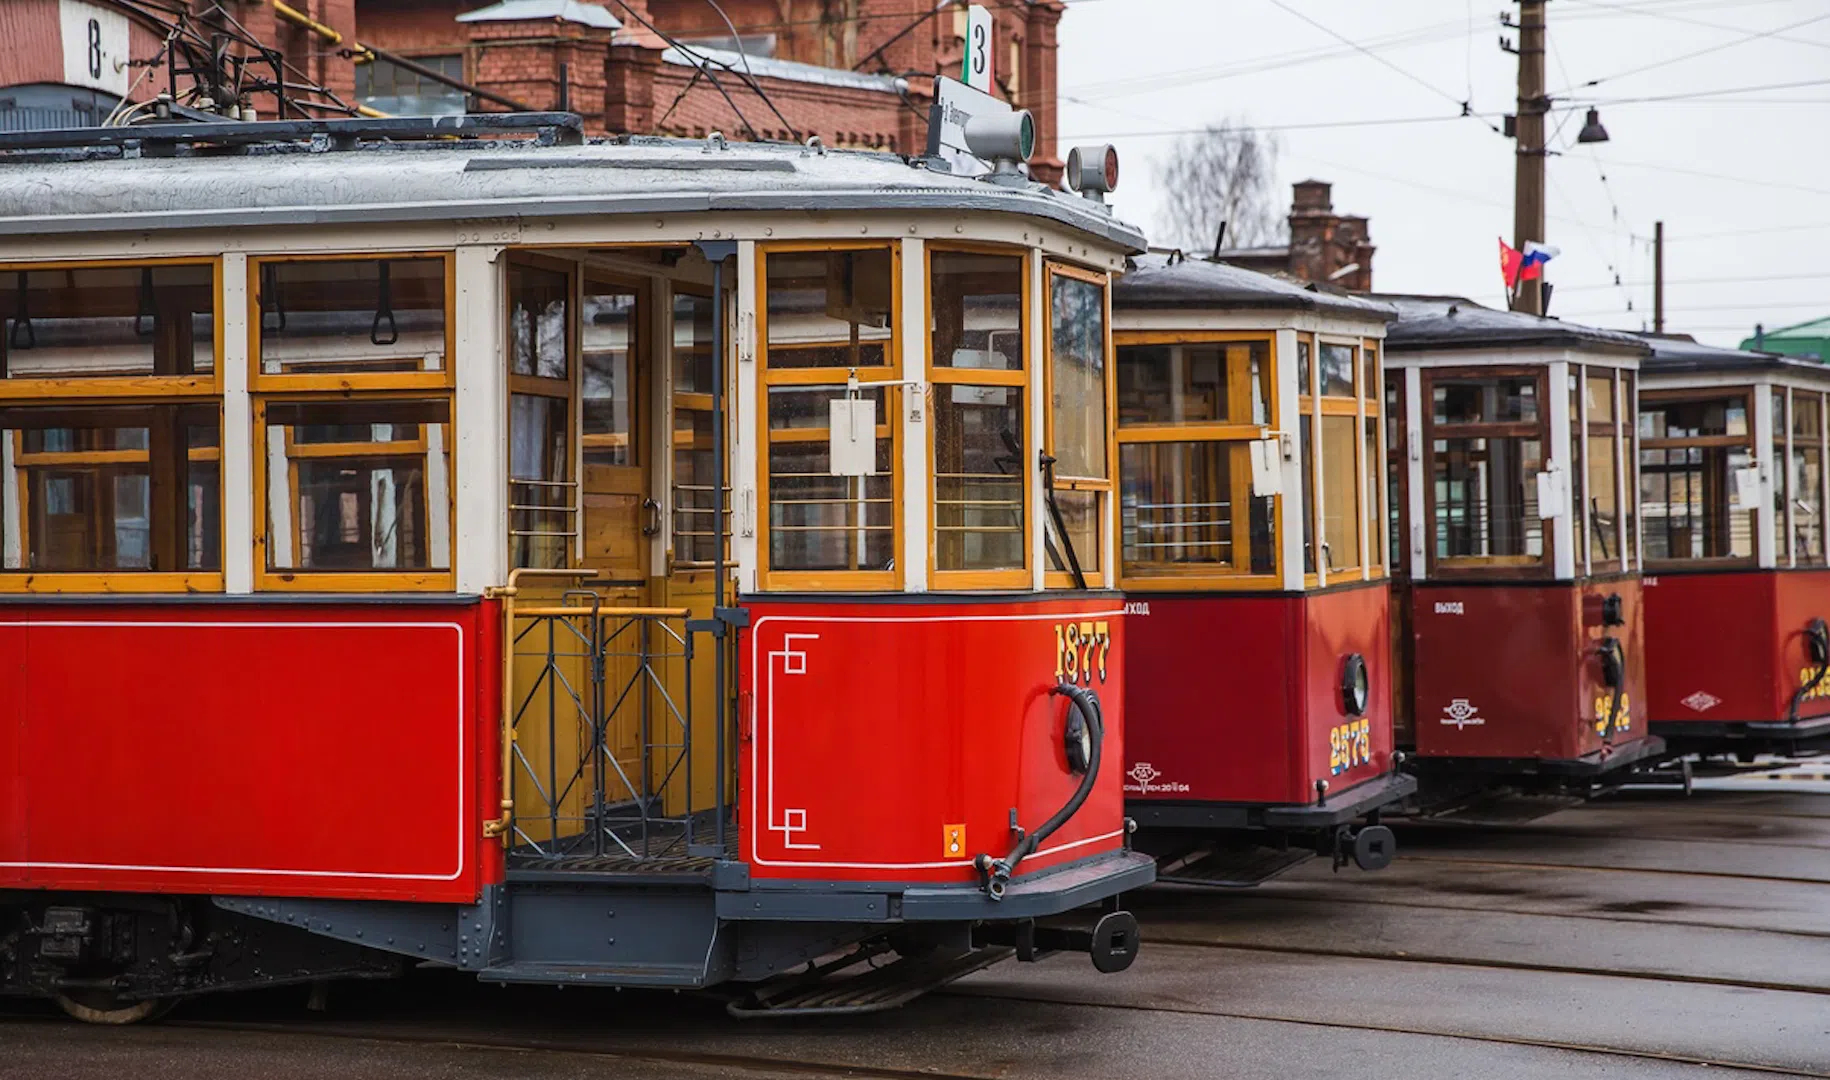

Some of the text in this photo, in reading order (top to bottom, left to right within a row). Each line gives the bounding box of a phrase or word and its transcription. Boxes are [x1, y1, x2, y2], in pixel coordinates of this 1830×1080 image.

[973, 24, 985, 75] 3
[1055, 621, 1110, 685] 1877
[1330, 718, 1369, 775] 2575
